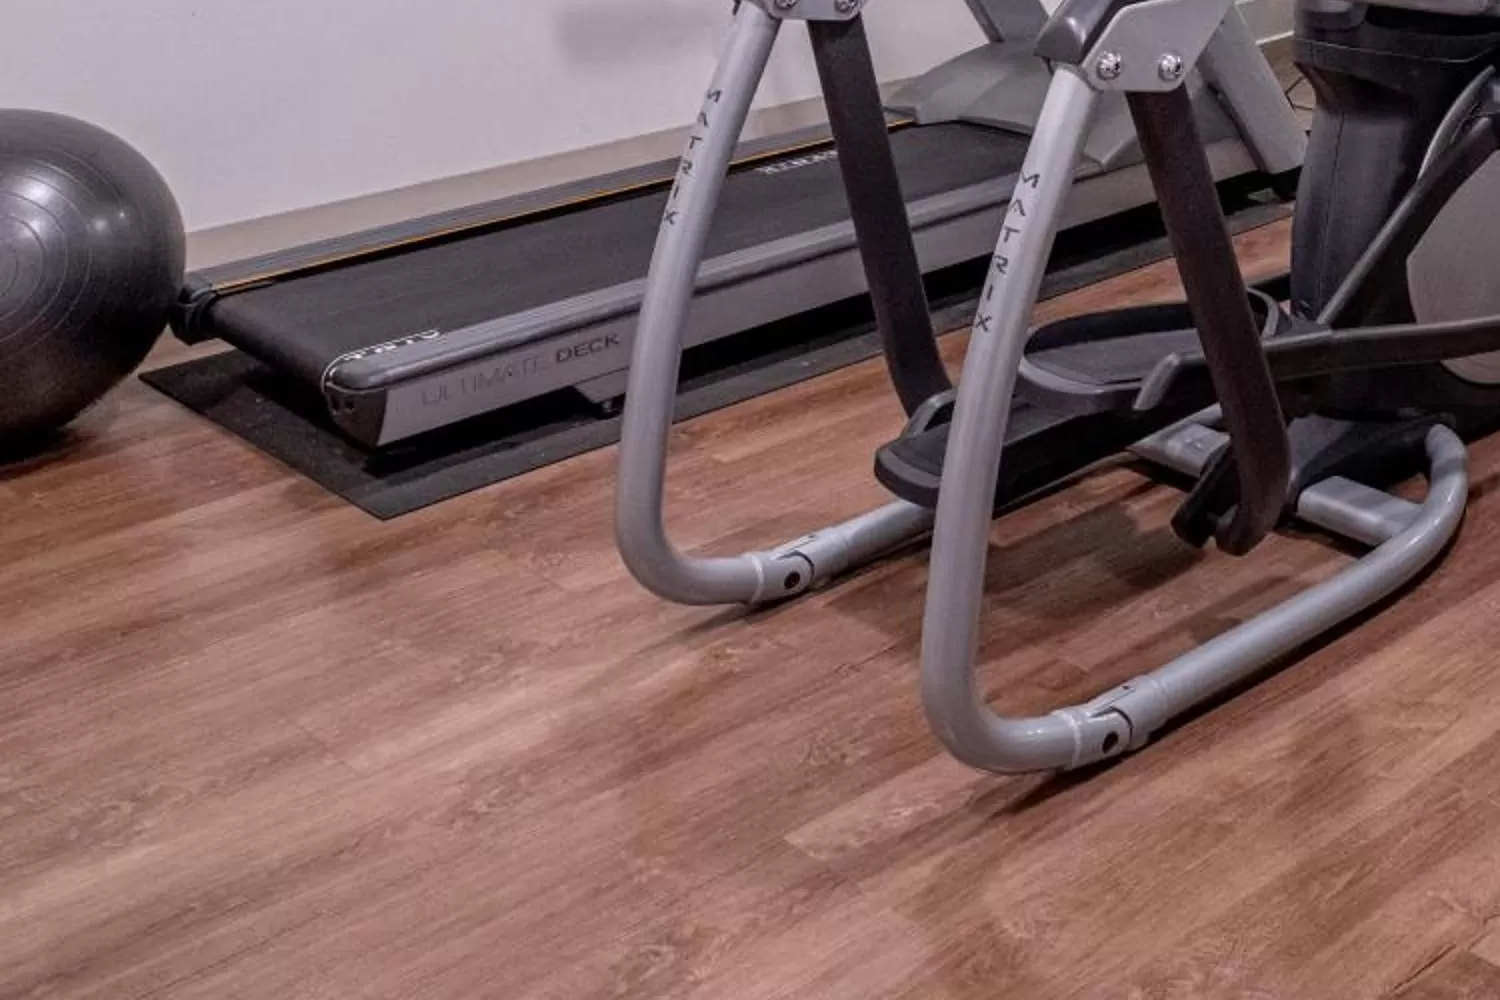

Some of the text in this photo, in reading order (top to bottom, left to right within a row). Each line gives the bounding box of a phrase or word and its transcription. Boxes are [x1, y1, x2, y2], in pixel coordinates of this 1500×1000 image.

[663, 88, 722, 225] MATRIX
[975, 171, 1041, 332] MATRIX
[556, 332, 620, 363] DECK
